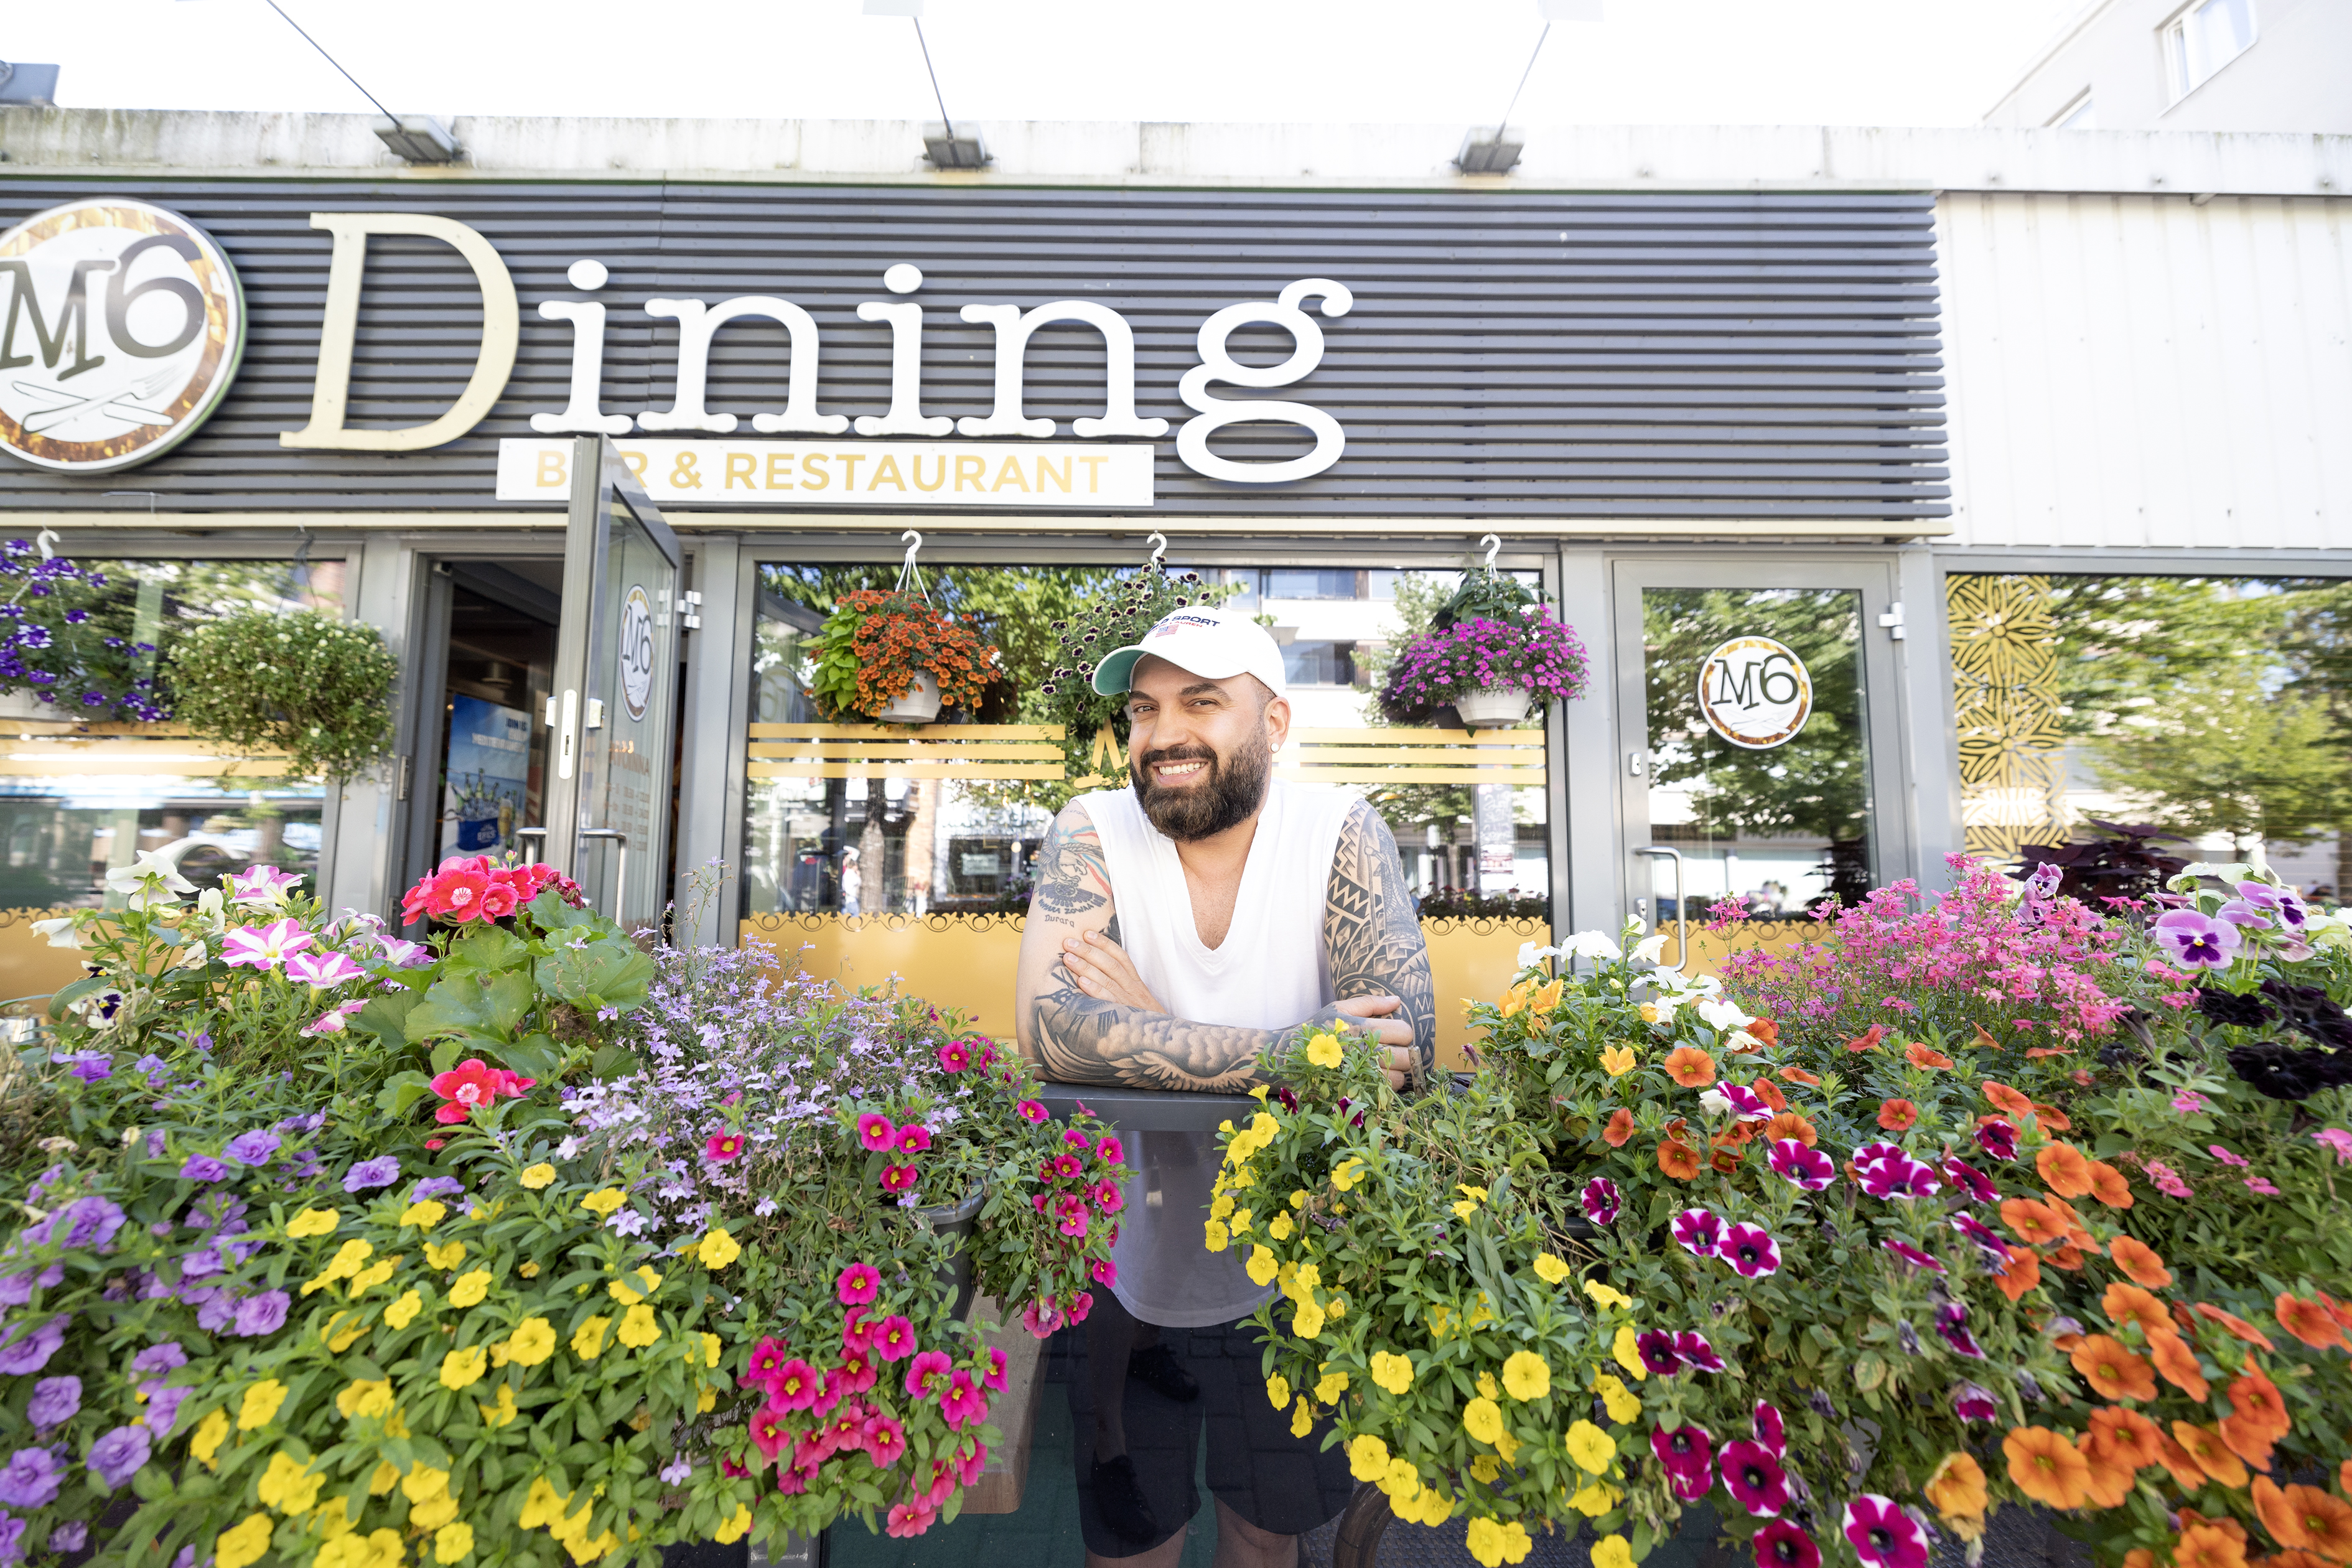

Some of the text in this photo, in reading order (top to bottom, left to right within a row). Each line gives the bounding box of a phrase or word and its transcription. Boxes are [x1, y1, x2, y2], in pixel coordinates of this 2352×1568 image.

[0, 234, 205, 381] M6
[279, 212, 1353, 483] Dining
[536, 450, 1109, 493] BR & RESTAURANT
[622, 602, 653, 675] M6
[1172, 615, 1220, 627] SPORT
[1712, 654, 1798, 711] M6
